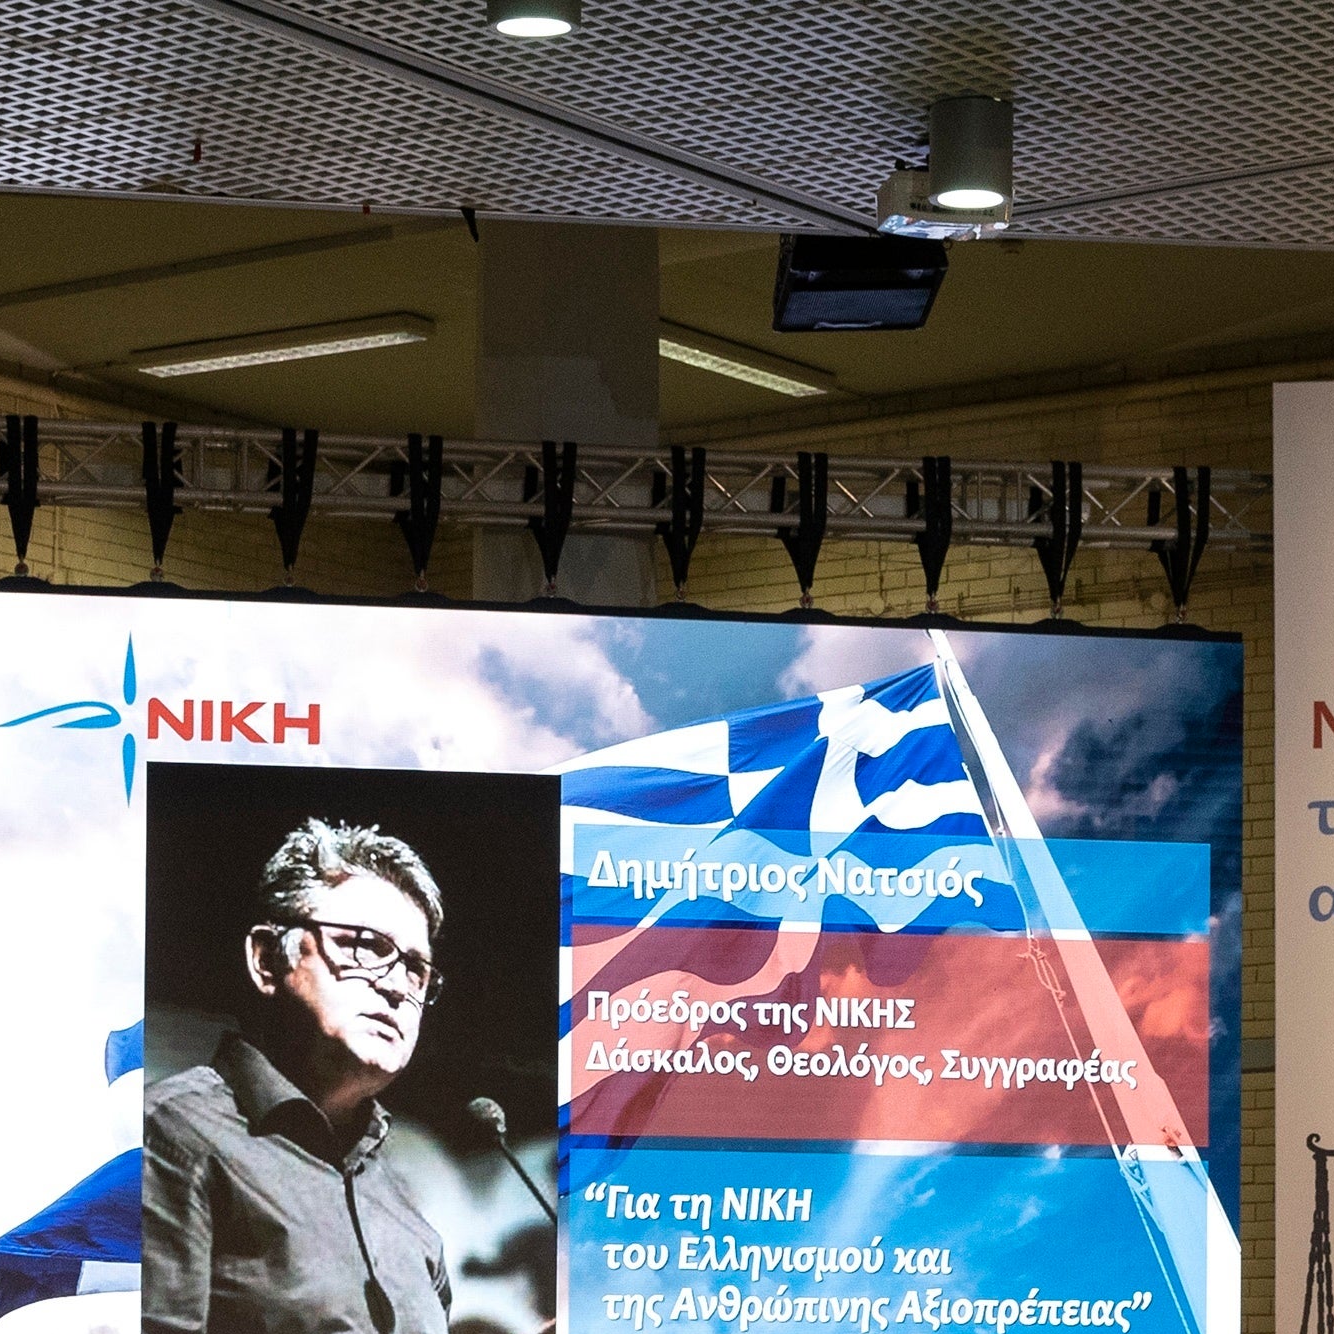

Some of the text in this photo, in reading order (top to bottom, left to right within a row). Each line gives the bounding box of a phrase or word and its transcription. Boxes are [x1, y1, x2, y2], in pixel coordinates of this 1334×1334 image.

[147, 697, 320, 745] ΝΙΚΗ
[587, 848, 984, 908] Δημήτριος Νατσιός
[587, 990, 916, 1033] Πρόεδρος της ΝΙΚΗΣ
[585, 1042, 1138, 1091] Δάσκαλος, Θεολόγος, Συγγραφέας
[584, 1184, 813, 1230] “Για τη ΝΙΚΗ
[603, 1235, 953, 1278] του Ελληνισμού και
[602, 1286, 1153, 1333] της Ανθρώπινης Αξιοπρέπειας”
